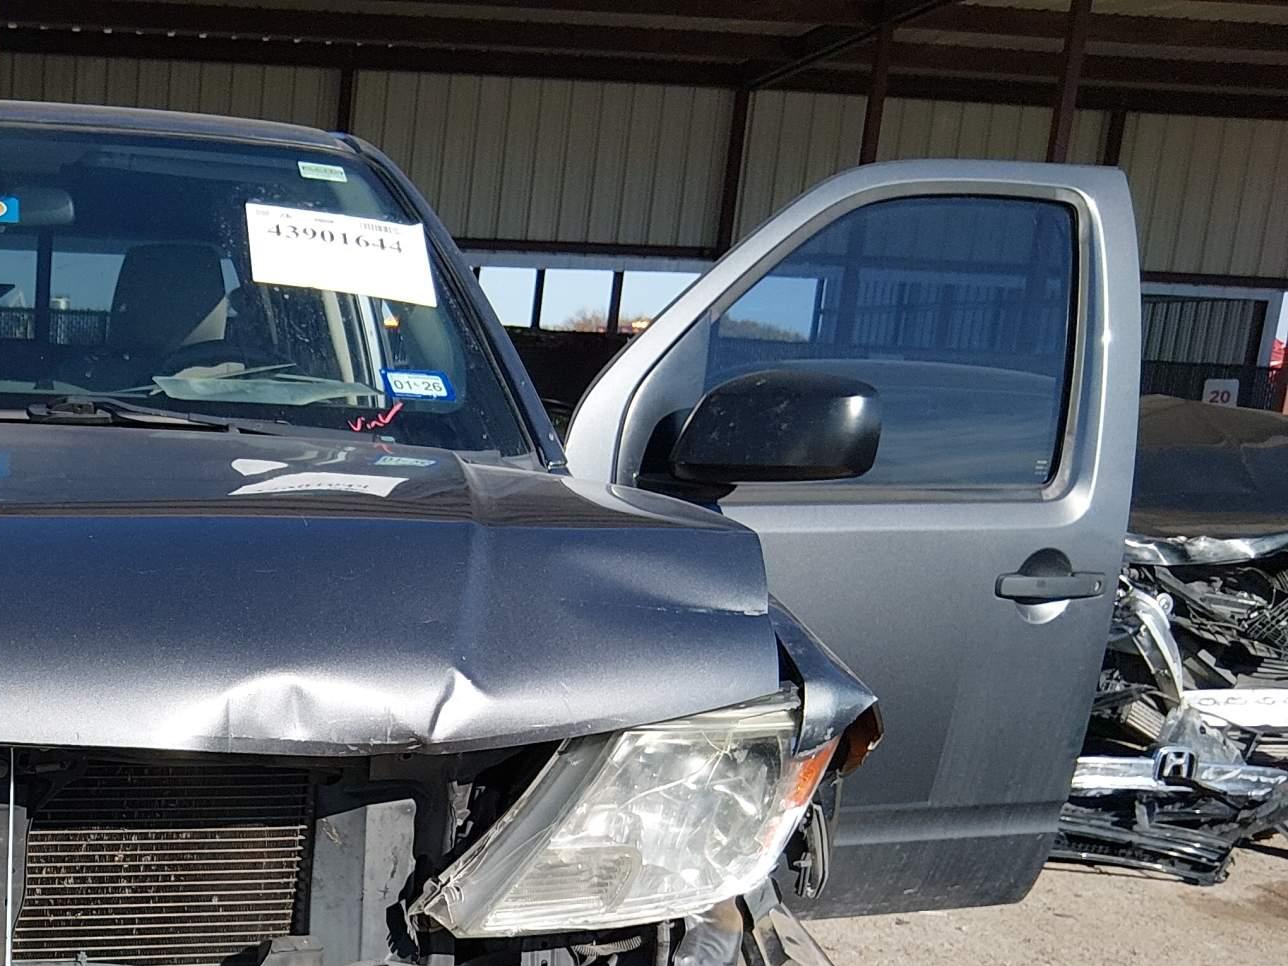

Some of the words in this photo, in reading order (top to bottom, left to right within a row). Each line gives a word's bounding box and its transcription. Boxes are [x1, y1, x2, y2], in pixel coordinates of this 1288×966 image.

[267, 224, 403, 254] 43901644
[394, 380, 414, 390] 01
[424, 381, 443, 392] 26
[1209, 390, 1231, 404] 20
